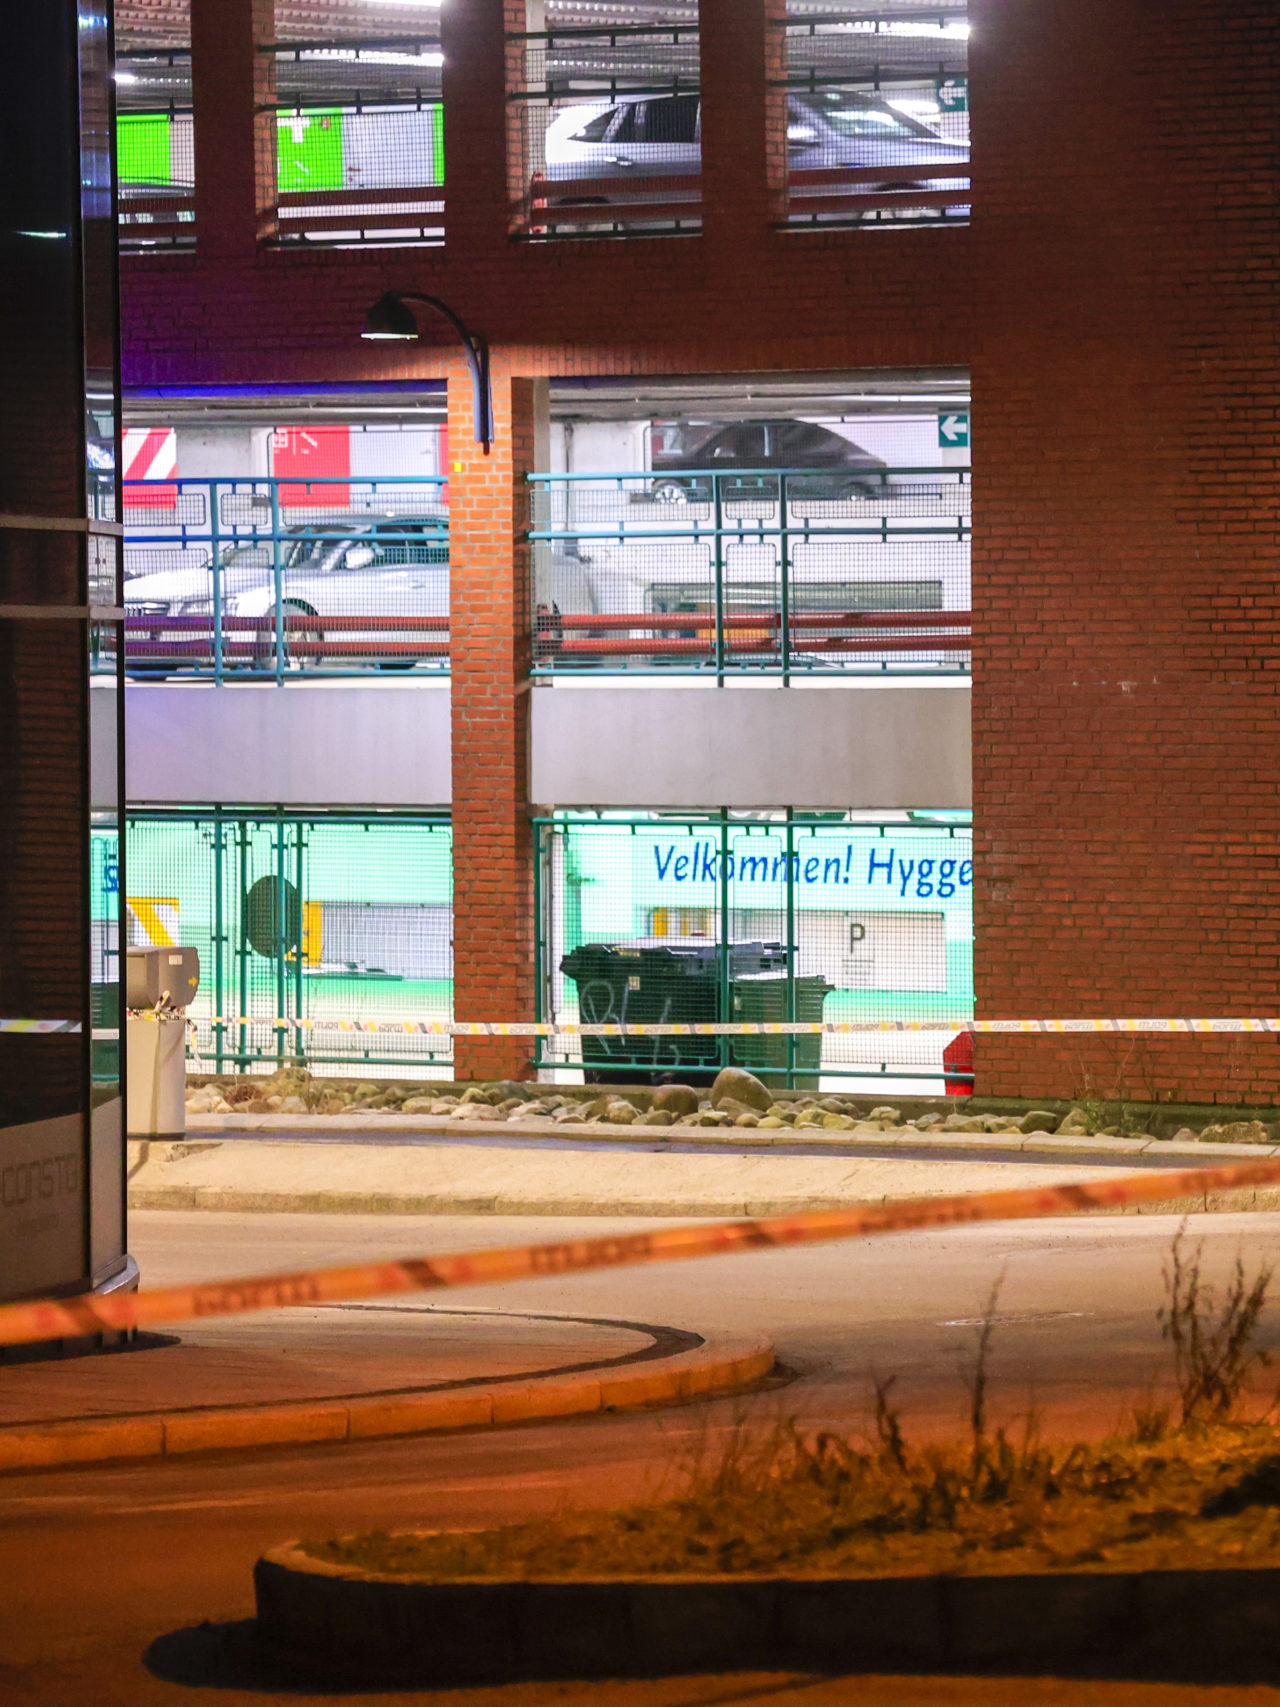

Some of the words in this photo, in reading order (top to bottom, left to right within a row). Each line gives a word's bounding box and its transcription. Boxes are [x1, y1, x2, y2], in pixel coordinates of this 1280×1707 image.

[654, 842, 852, 885] Velkommen!
[867, 848, 973, 898] Hygge
[850, 923, 866, 953] P
